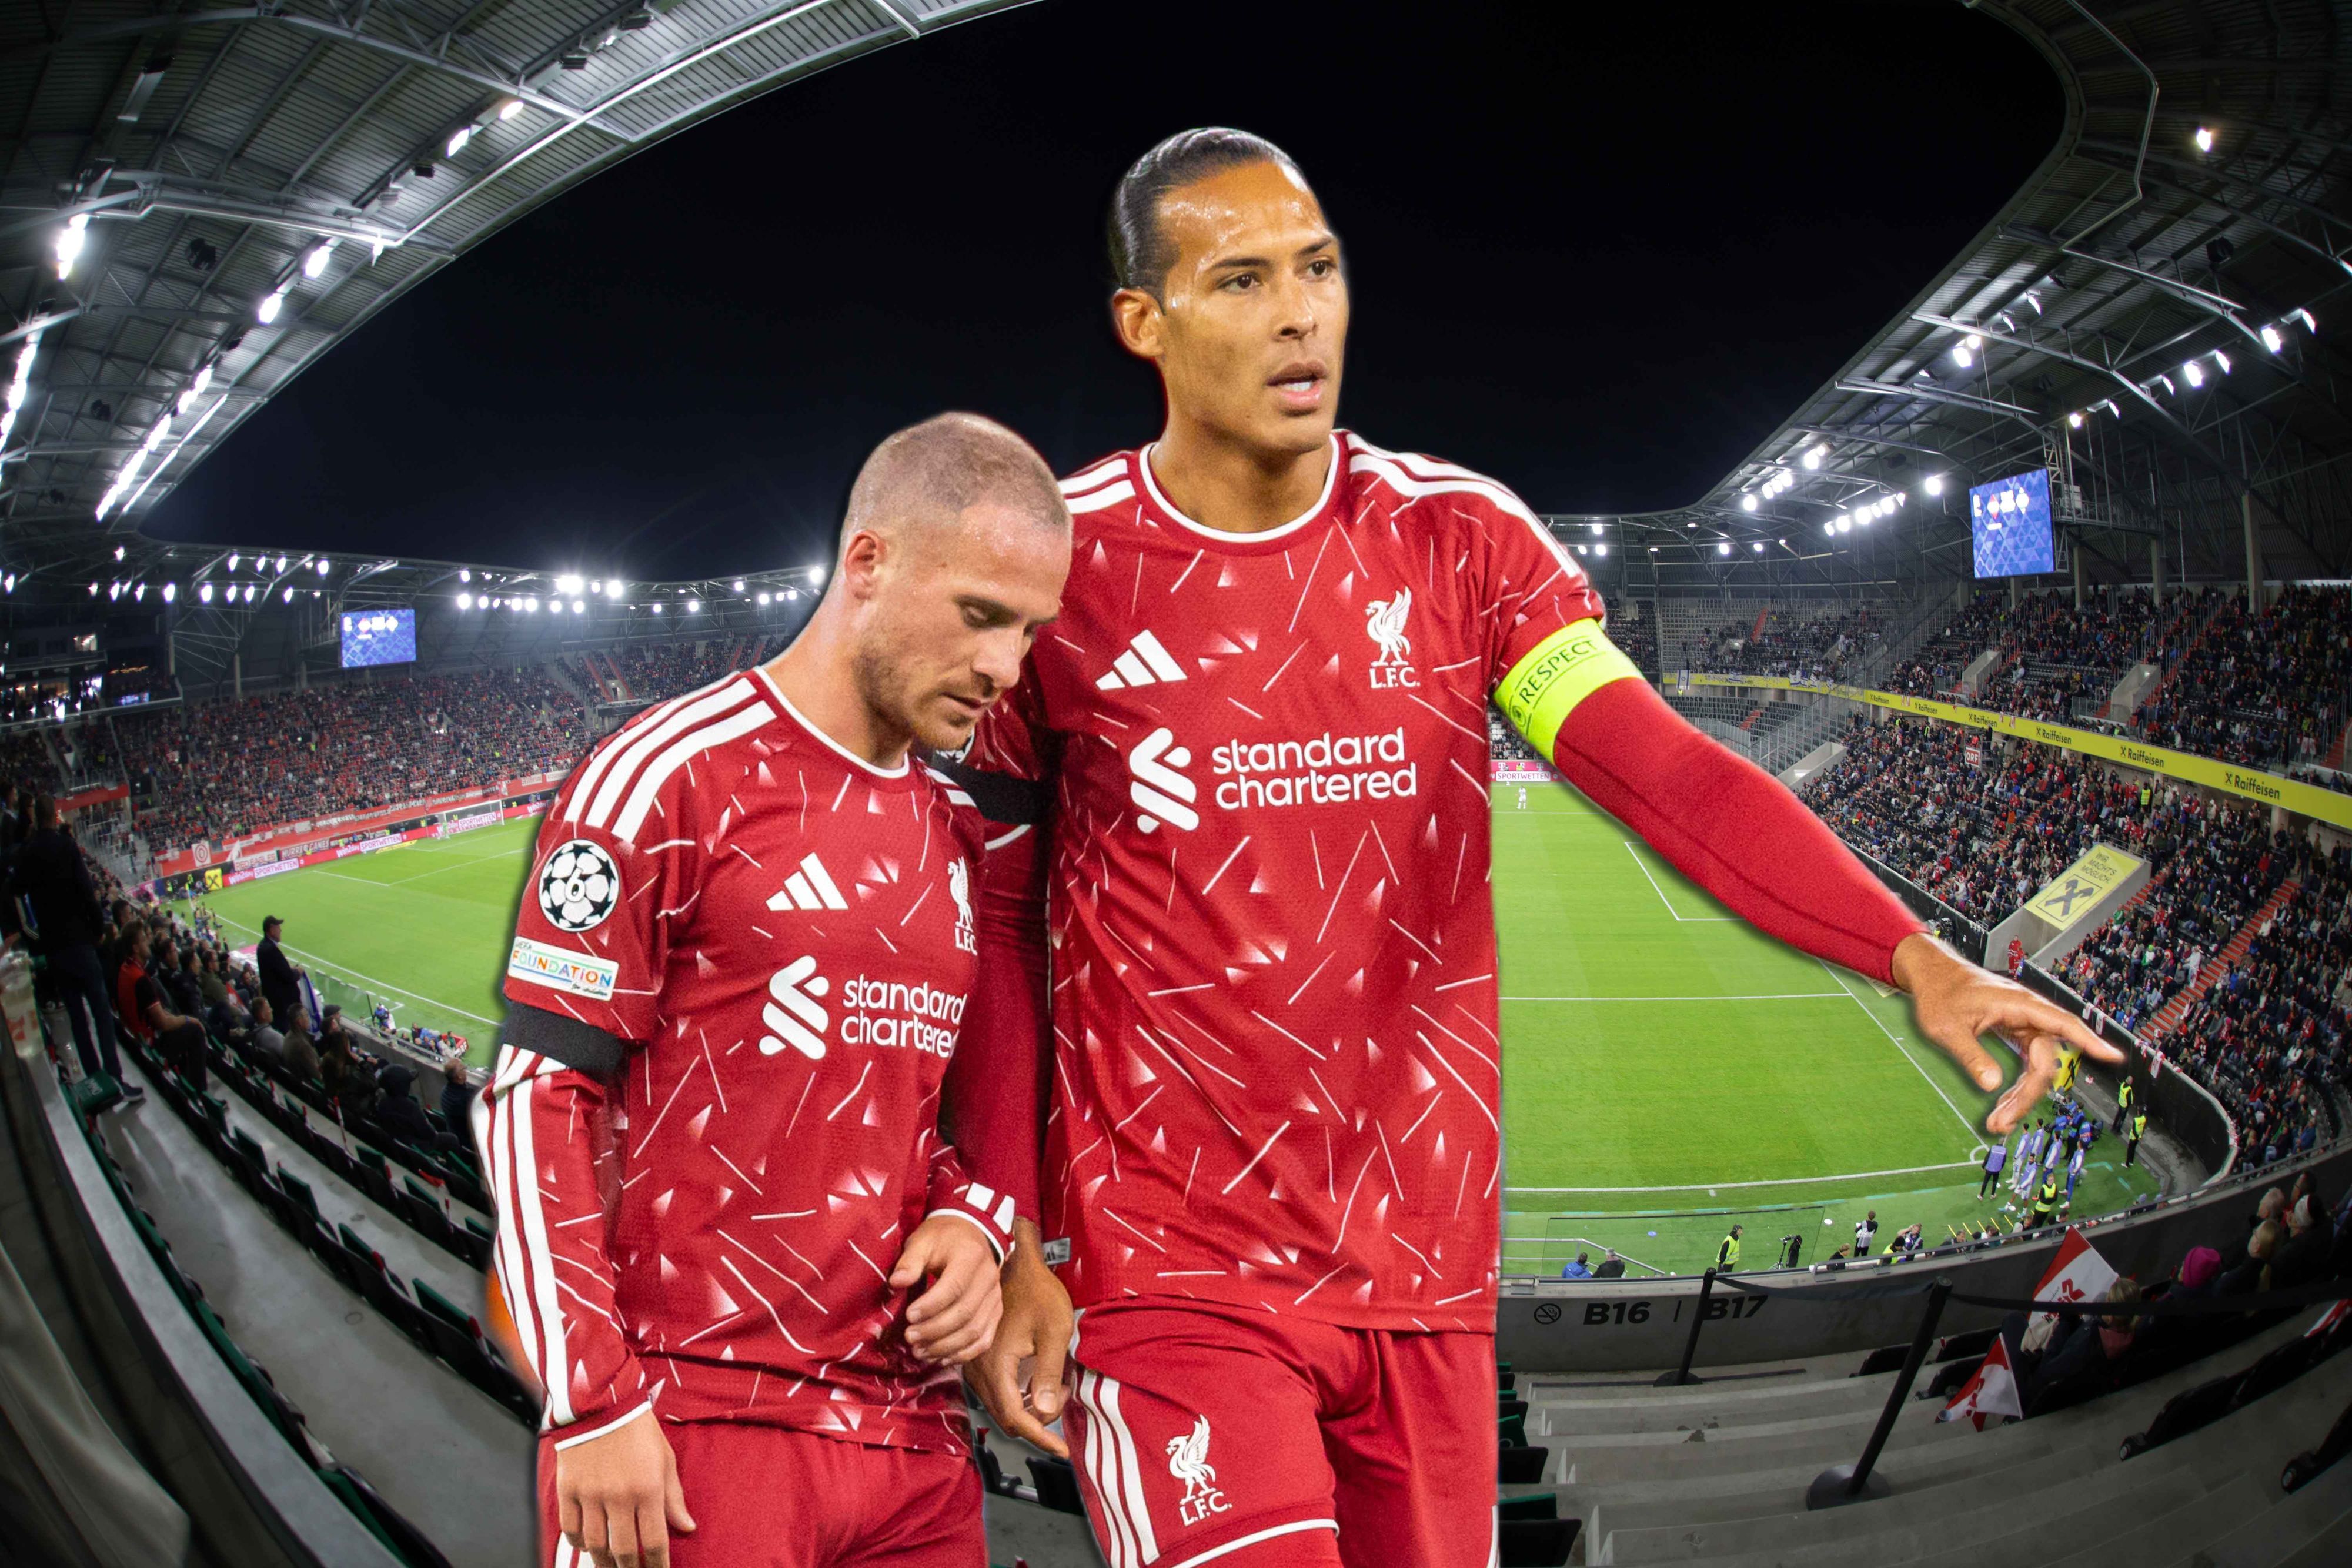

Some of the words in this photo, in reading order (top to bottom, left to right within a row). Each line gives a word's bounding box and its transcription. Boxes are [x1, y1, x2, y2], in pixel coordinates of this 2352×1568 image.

[1369, 667, 1421, 689] L.F.C.
[1519, 640, 1597, 704] RESPECT
[1918, 703, 1938, 714] Raiffeisen
[1973, 714, 1997, 727] Raiffeisen
[2042, 728, 2072, 745] Raiffeisen
[1211, 726, 1405, 775] standard
[1966, 751, 1979, 763] ORF
[2127, 748, 2164, 768] Raiffeisen
[1215, 761, 1417, 810] chartered
[2234, 774, 2280, 800] Raiffeisen
[360, 835, 400, 850] SPORTWETTEN
[255, 859, 298, 875] SPORTWETTEN
[565, 867, 587, 903] 6
[512, 950, 612, 987] FOUNDATION
[843, 973, 968, 1025] standard
[1583, 1301, 1651, 1325] B16
[1702, 1295, 1768, 1321] B17
[1179, 1491, 1233, 1527] L.F.C.
